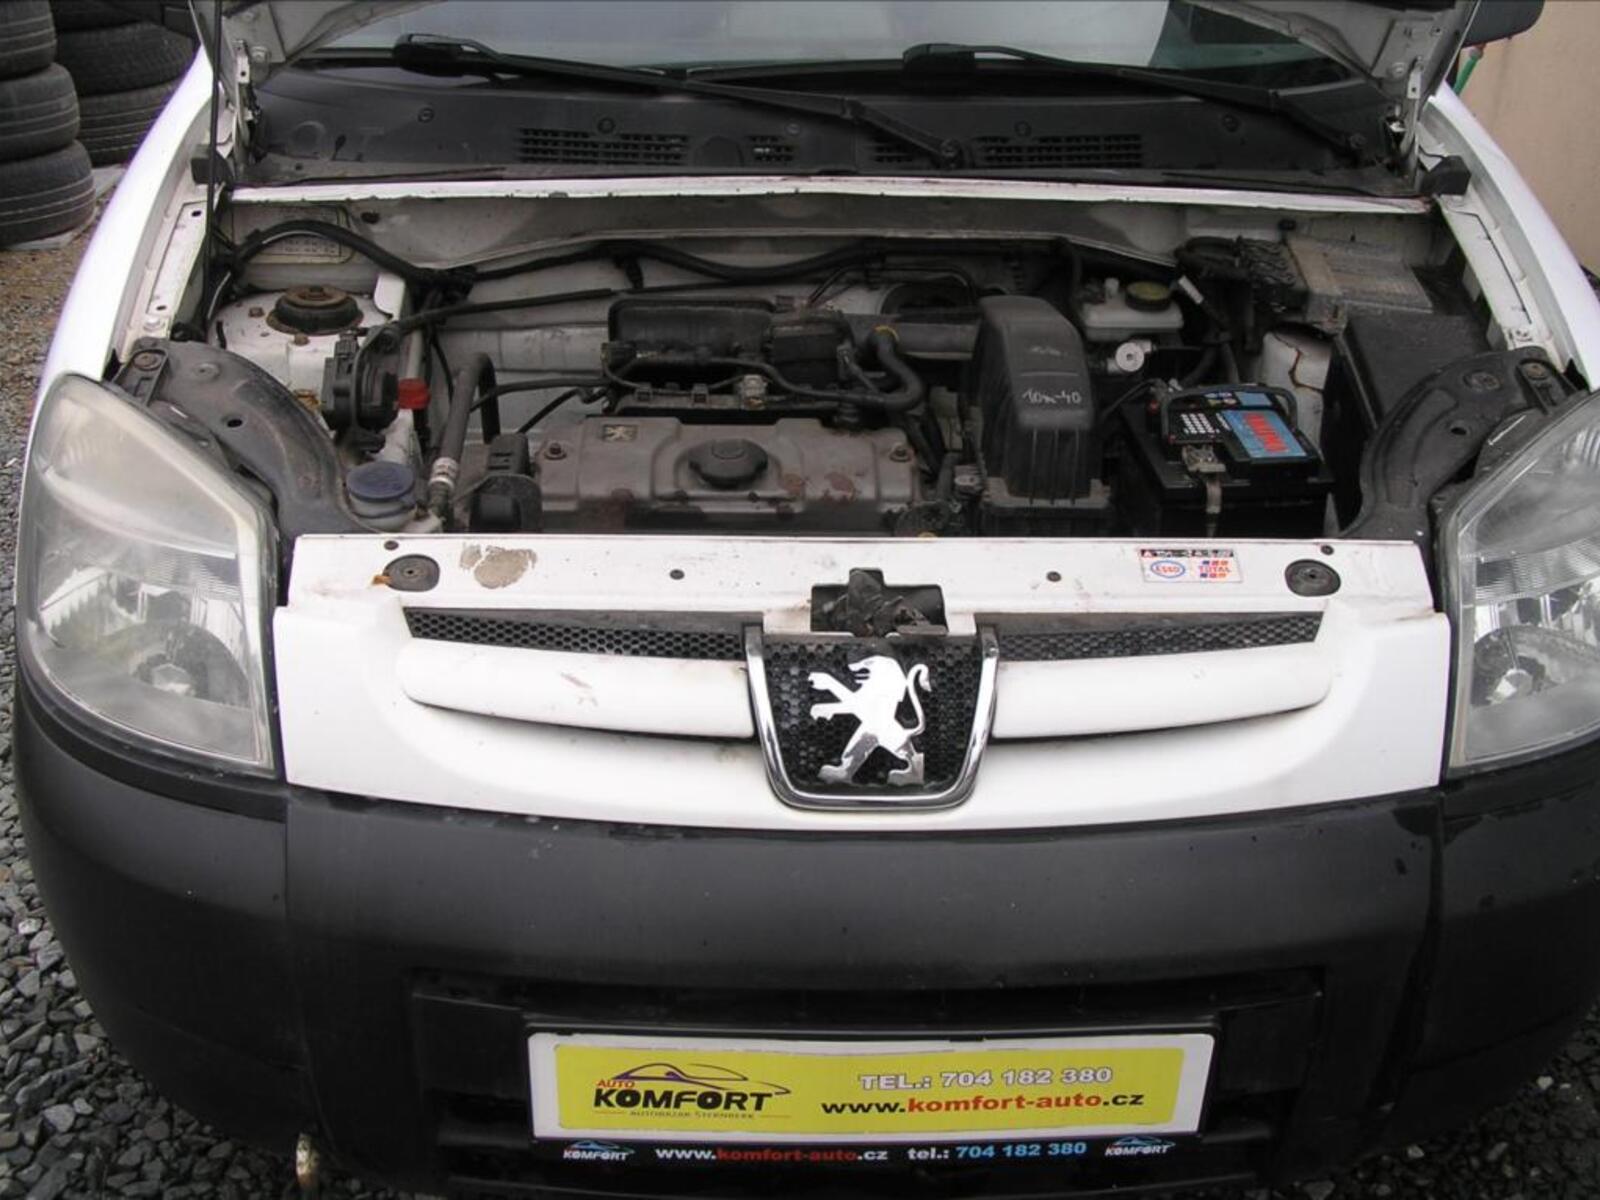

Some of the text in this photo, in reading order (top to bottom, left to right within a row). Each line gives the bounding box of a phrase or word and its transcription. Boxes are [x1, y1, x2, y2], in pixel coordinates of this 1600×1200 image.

[597, 1079, 636, 1089] AUTO
[860, 1066, 1113, 1090] TEL.: 704 182 380
[595, 1089, 772, 1112] KOMFORT
[822, 1093, 1145, 1115] www.komfort-auto.cz
[563, 1150, 629, 1161] KOMFORT
[655, 1142, 1088, 1163] www.komfort-auto.cz tel.: 704 182 380
[1105, 1145, 1170, 1156] KOMFORT
